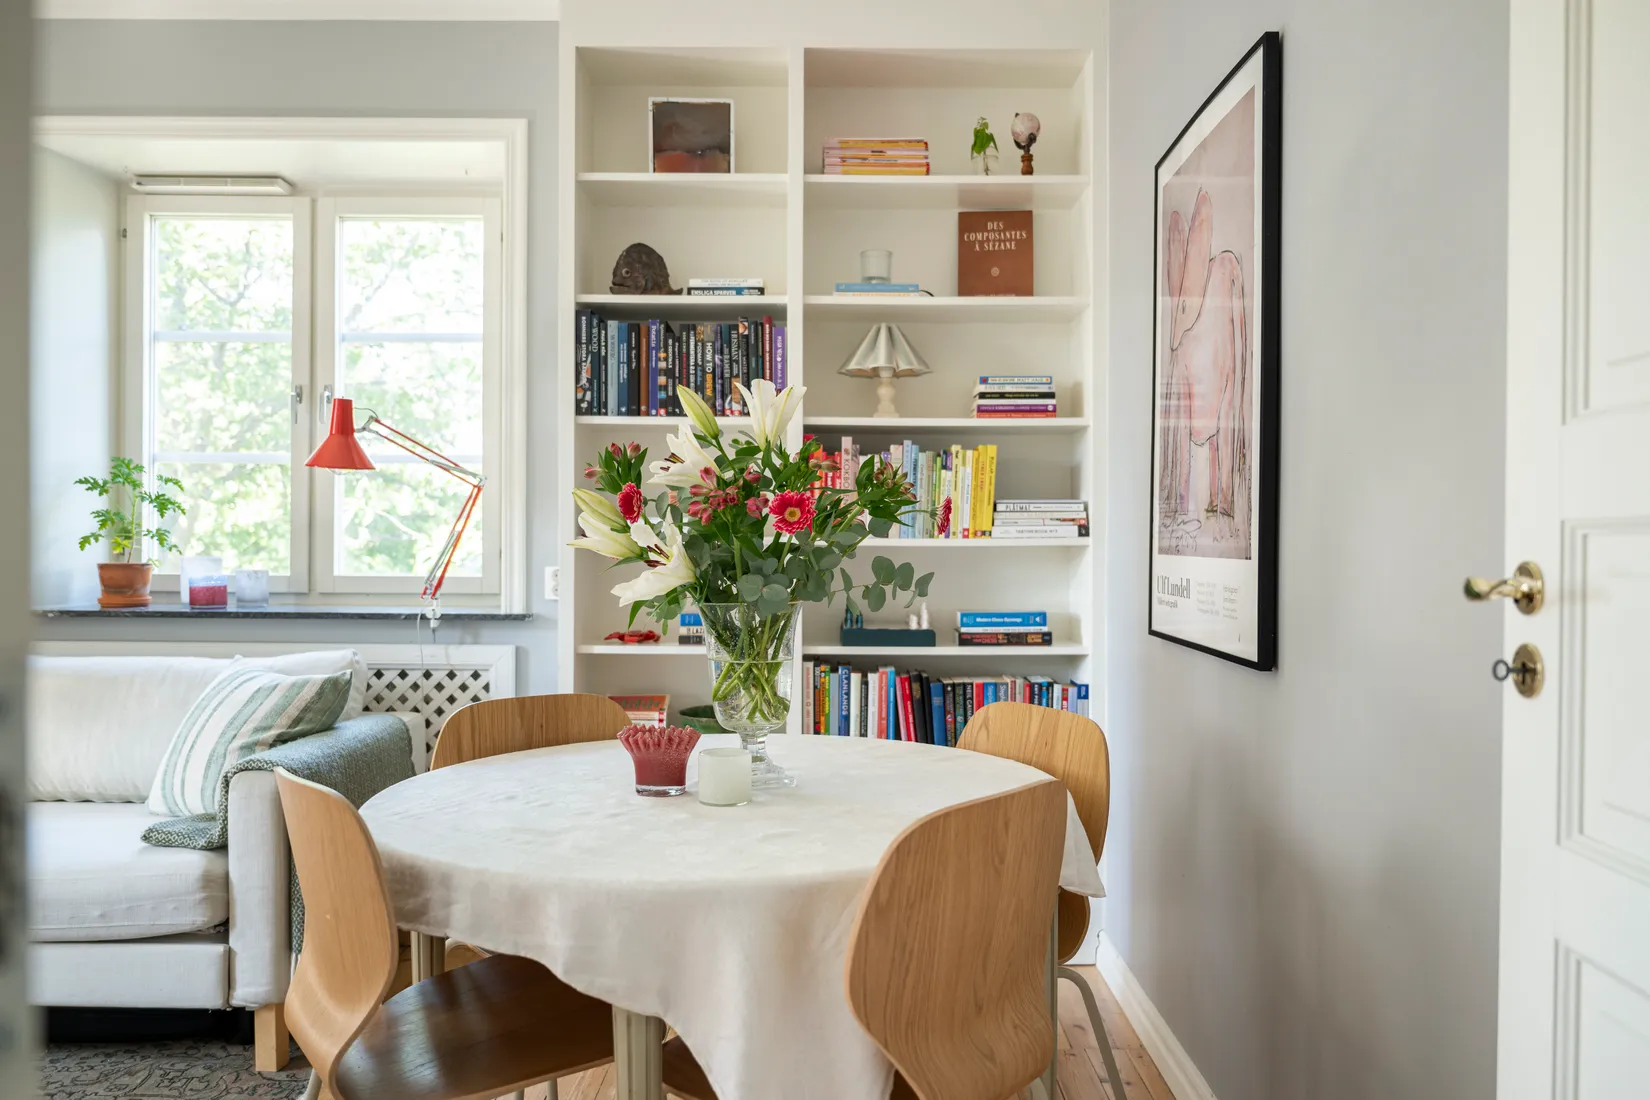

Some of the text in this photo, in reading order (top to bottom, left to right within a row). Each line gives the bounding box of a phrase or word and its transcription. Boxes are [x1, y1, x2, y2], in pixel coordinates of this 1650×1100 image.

[987, 221, 1004, 230] DES
[964, 230, 1027, 242] COMPOSANTES
[984, 240, 1016, 251] SÉZANE
[706, 362, 712, 372] TO
[1167, 576, 1190, 599] Lundell
